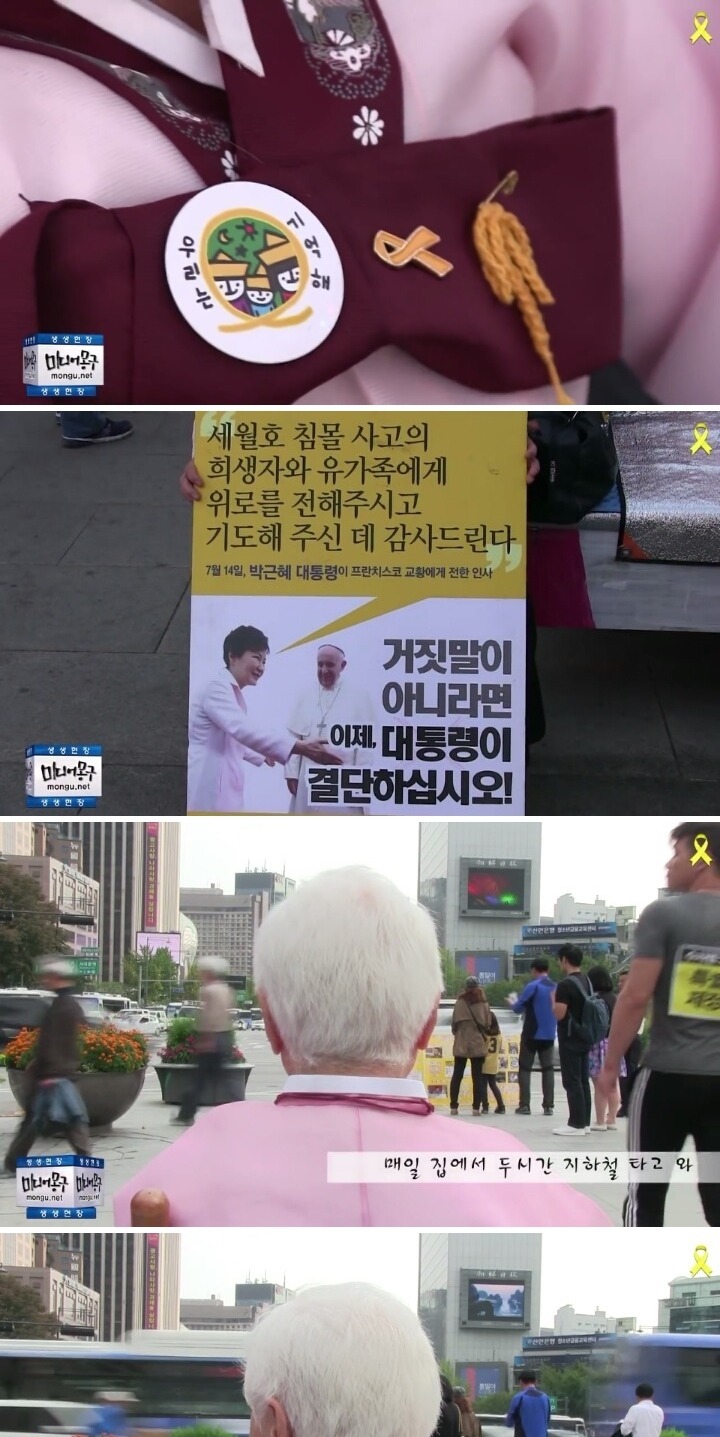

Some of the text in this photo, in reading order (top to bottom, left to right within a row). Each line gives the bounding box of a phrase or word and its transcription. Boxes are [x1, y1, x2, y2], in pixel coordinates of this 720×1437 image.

[287, 211, 330, 290] 기억해
[179, 236, 213, 310] 우리는
[207, 422, 429, 452] 세월호 침몰 사고의
[207, 456, 447, 486] 희생자와 유가족에게
[207, 489, 422, 519] 위로를 전해주시고
[206, 522, 517, 554] 기도해 주신 데 감사드린다
[206, 564, 493, 580] 7월 14일, 박근혜 대통령이 프란치스코 교황에게 전한 인사
[383, 639, 512, 675] 거짓말이
[382, 681, 512, 718] 아니라면
[330, 724, 511, 762] 이제, 대통령이
[308, 768, 513, 805] 결단하십시오!
